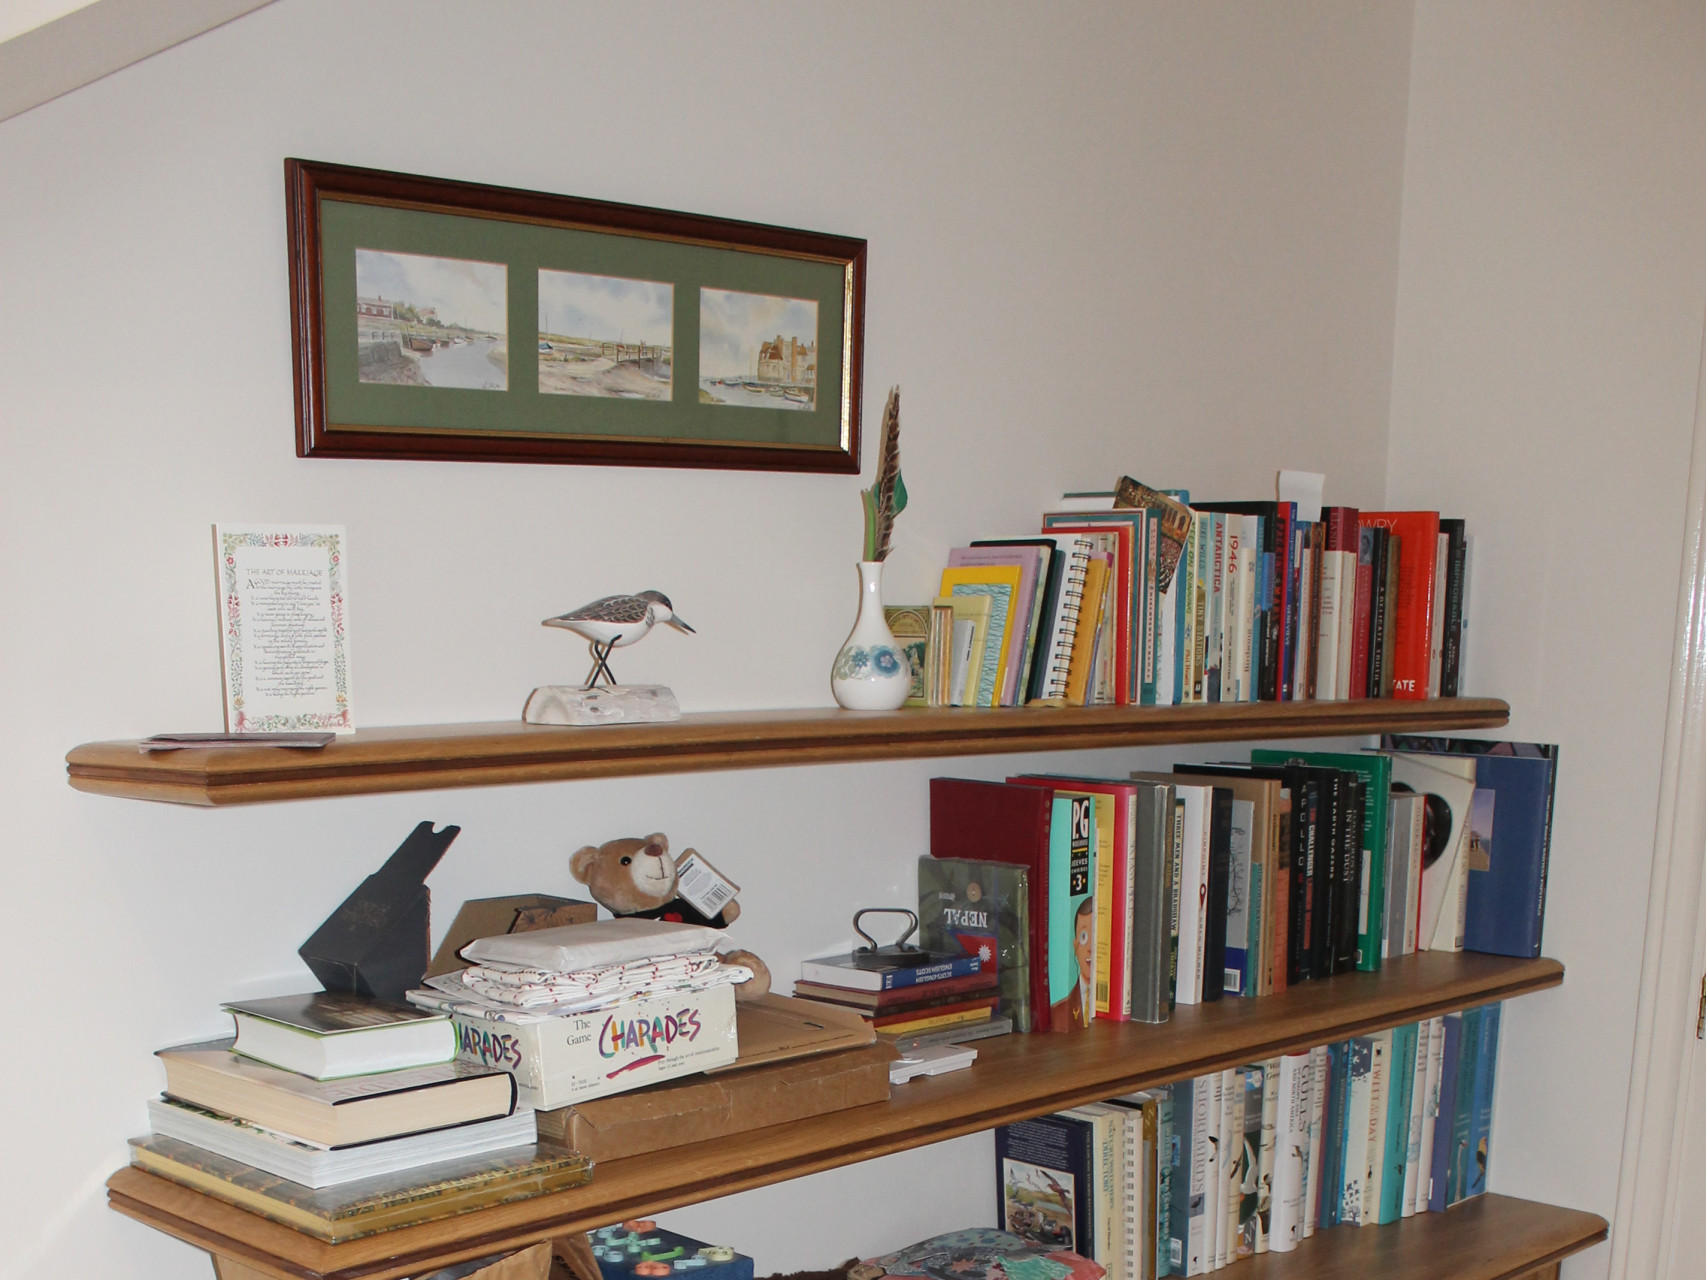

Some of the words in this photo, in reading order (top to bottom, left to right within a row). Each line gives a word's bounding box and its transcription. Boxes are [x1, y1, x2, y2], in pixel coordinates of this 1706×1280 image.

[1187, 550, 1195, 567] ON
[1199, 543, 1207, 570] WILLS
[1213, 522, 1224, 593] ANTARCTICA
[1228, 535, 1239, 573] 1946
[286, 569, 322, 577] MARRIAGE
[1186, 571, 1194, 614] RUNNING
[1195, 626, 1203, 666] STATIONS
[1346, 809, 1353, 822] IN
[1306, 825, 1316, 877] CHALLENGER
[1344, 827, 1352, 850] THE
[1071, 858, 1088, 868] JEEVES
[1342, 854, 1351, 883] DUST
[1075, 874, 1084, 891] 3
[943, 908, 988, 928] NEPAL
[1171, 888, 1179, 931] BRADSHAW
[573, 1018, 591, 1031] The
[598, 1008, 702, 1059] CHARADES
[566, 1034, 591, 1046] Game
[1371, 1062, 1382, 1101] TWEET
[1298, 1065, 1310, 1132] GULLS
[1195, 1080, 1208, 1192] SHOREBIRDS
[1367, 1118, 1378, 1142] DAY
